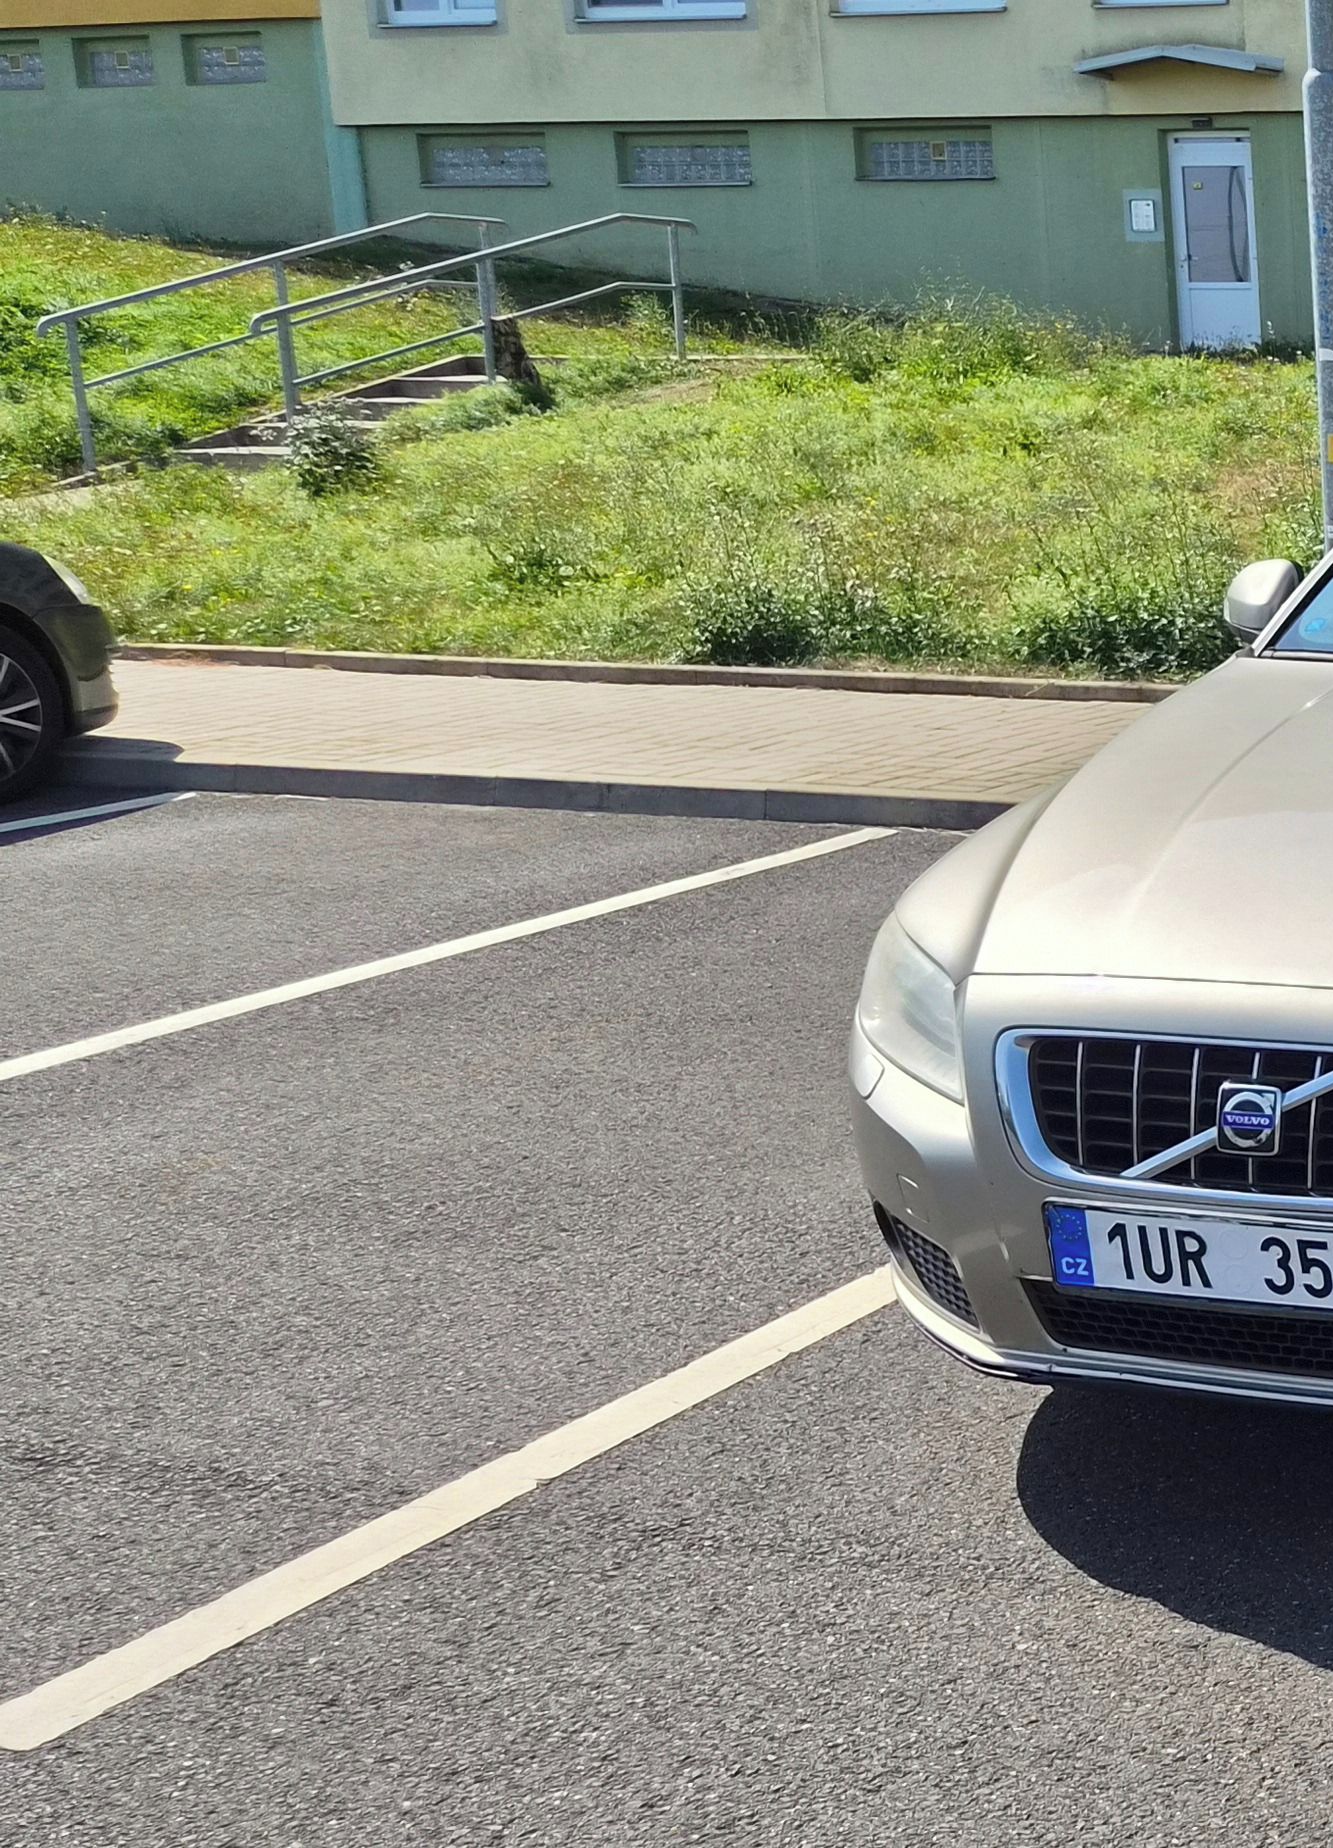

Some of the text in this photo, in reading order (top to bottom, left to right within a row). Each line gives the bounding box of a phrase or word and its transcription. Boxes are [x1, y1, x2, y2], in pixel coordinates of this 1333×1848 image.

[1225, 1114, 1270, 1126] VOLVO
[1107, 1222, 1213, 1289] 1UR
[1061, 1256, 1089, 1276] CZ
